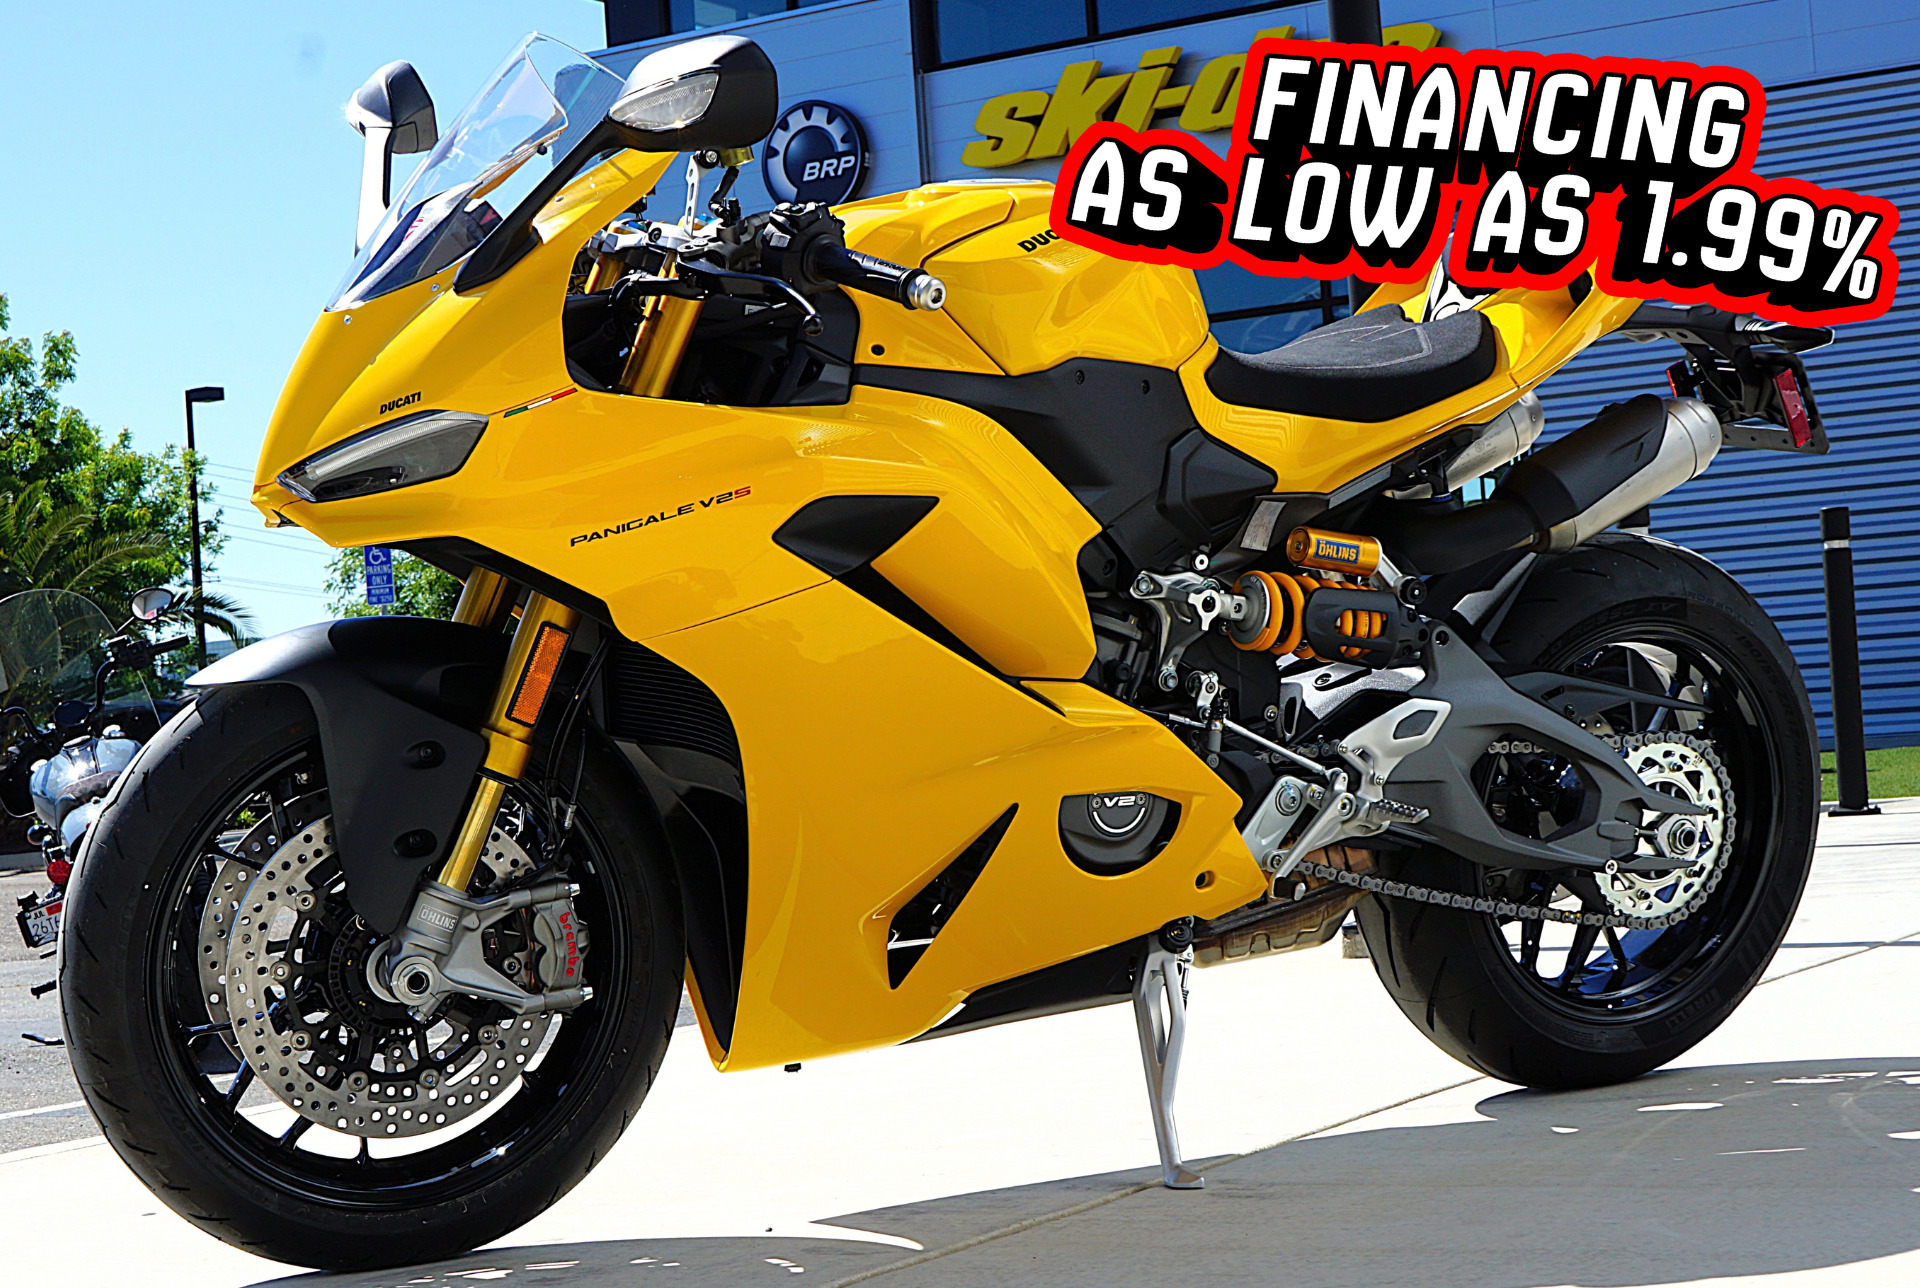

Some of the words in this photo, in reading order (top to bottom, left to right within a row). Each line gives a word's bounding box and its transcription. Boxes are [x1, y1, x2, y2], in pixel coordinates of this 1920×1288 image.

[961, 23, 1442, 168] ski-d
[803, 155, 856, 182] BRP
[1017, 229, 1061, 253] DUC
[379, 391, 422, 415] DUCATI
[570, 502, 695, 547] PANIGALE
[698, 485, 751, 509] V2S
[1317, 540, 1358, 562] ÖHLINS
[367, 564, 391, 575] PARKING
[372, 575, 387, 585] ONLY
[1103, 795, 1136, 807] V2
[420, 905, 457, 930] ÖHLINS
[559, 911, 580, 978] brembo
